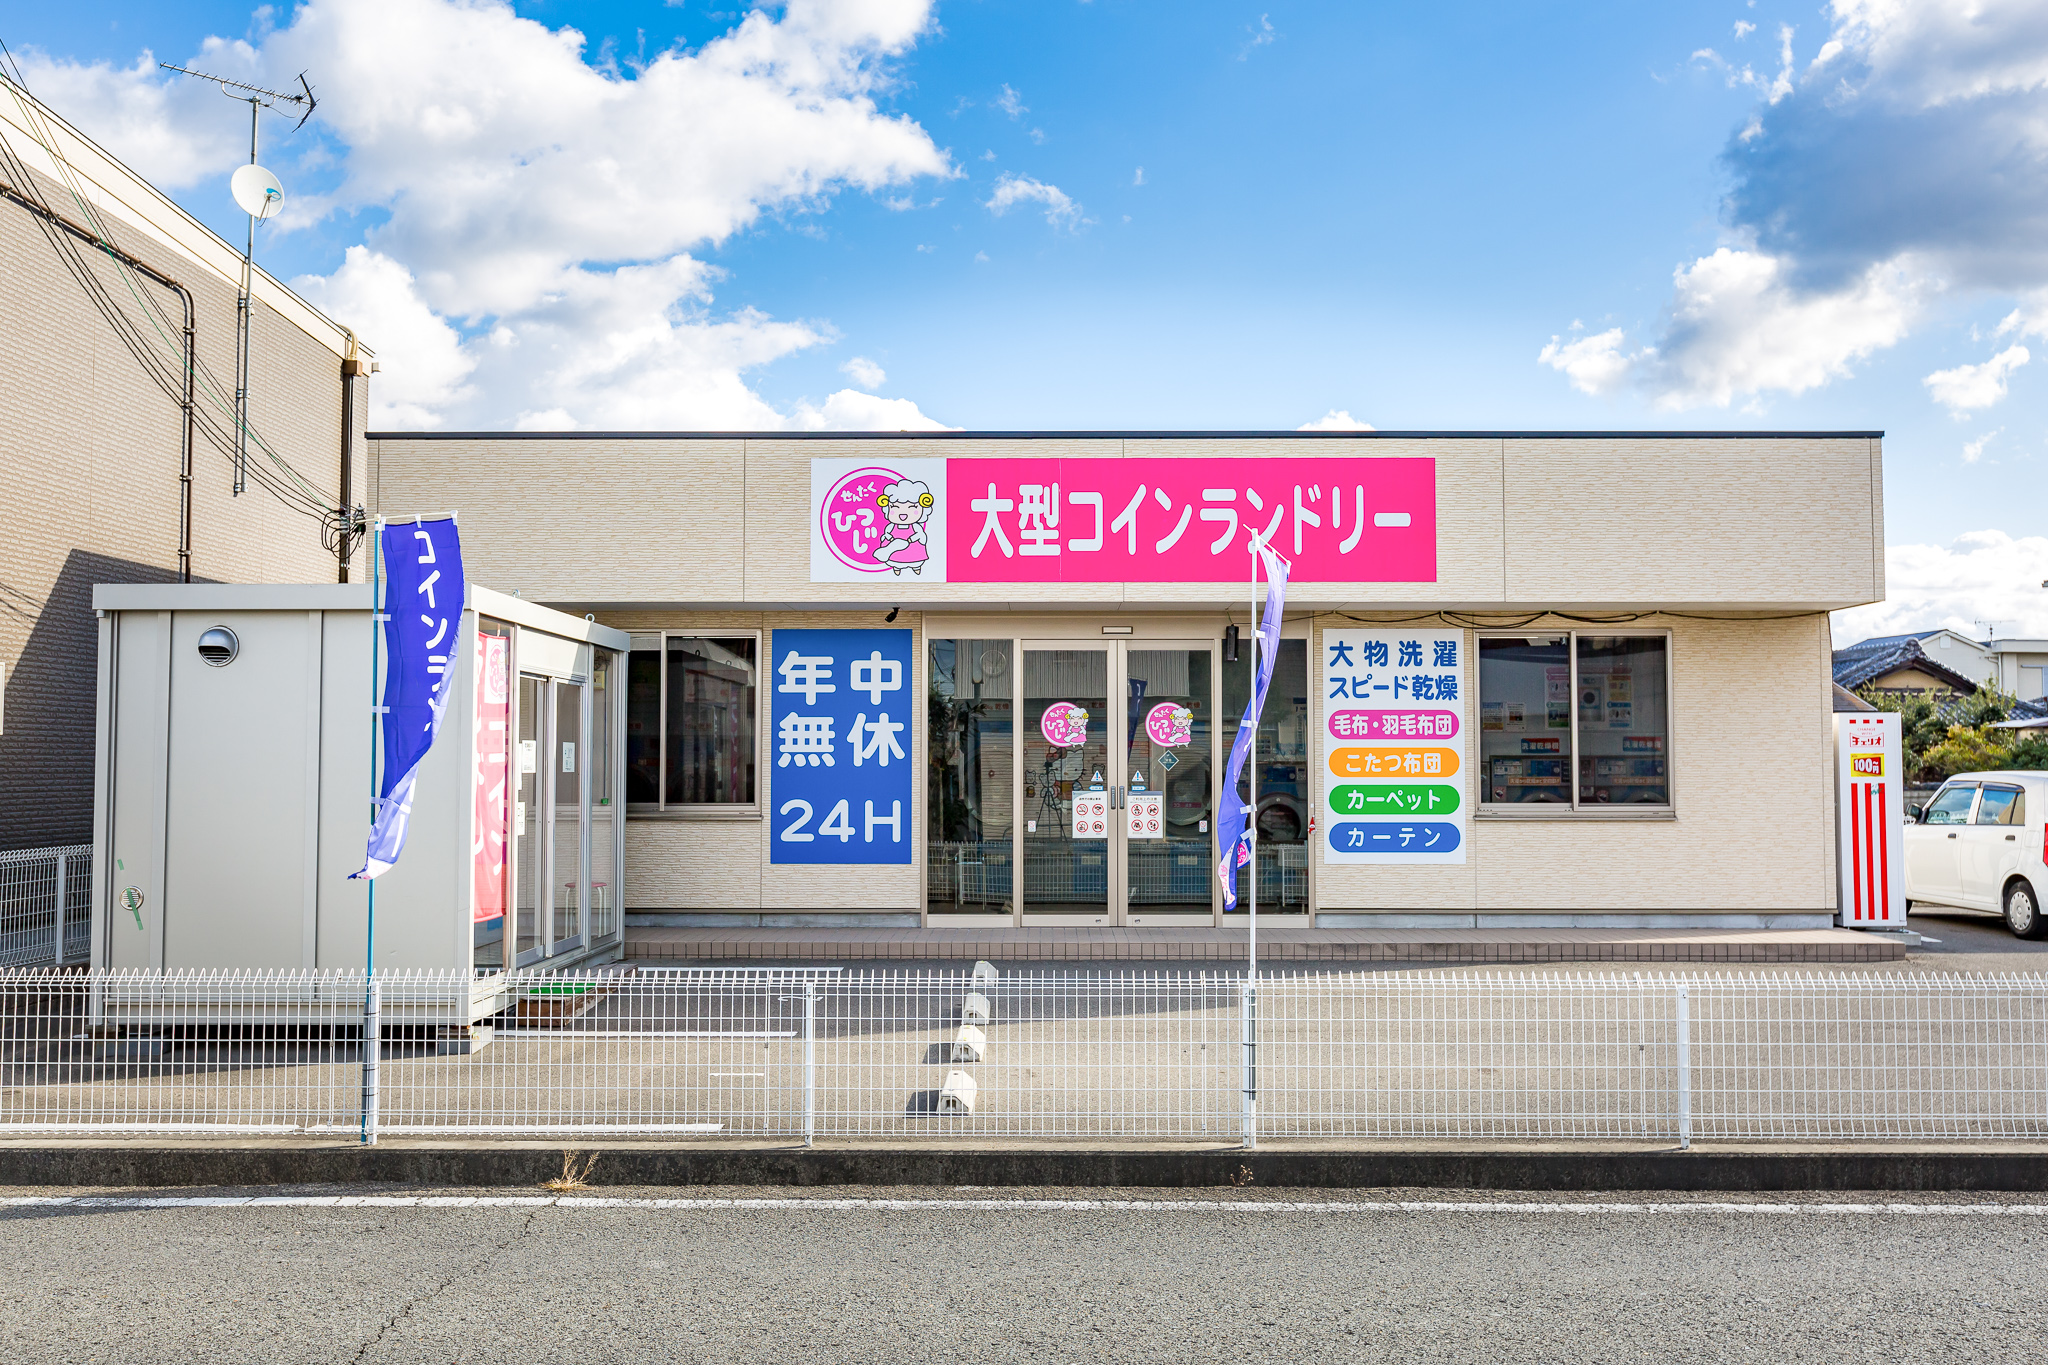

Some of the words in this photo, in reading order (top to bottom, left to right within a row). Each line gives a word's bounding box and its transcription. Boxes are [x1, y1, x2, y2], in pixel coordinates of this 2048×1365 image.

[841, 481, 877, 503] せんたく
[830, 508, 878, 554] ひつじ
[970, 482, 1412, 557] 大型コインランドリー
[1329, 640, 1458, 668] 大物洗濯
[777, 650, 903, 706] 年中
[1329, 673, 1459, 702] スピード乾燥
[1334, 713, 1453, 736] 毛布・羽毛布団
[777, 711, 906, 769] 無休
[1851, 735, 1882, 746] チェリオ
[1345, 752, 1442, 775] こたつ布団
[1347, 789, 1441, 811] カーペット
[780, 799, 902, 843] 24H
[1347, 827, 1442, 848] カーテン
